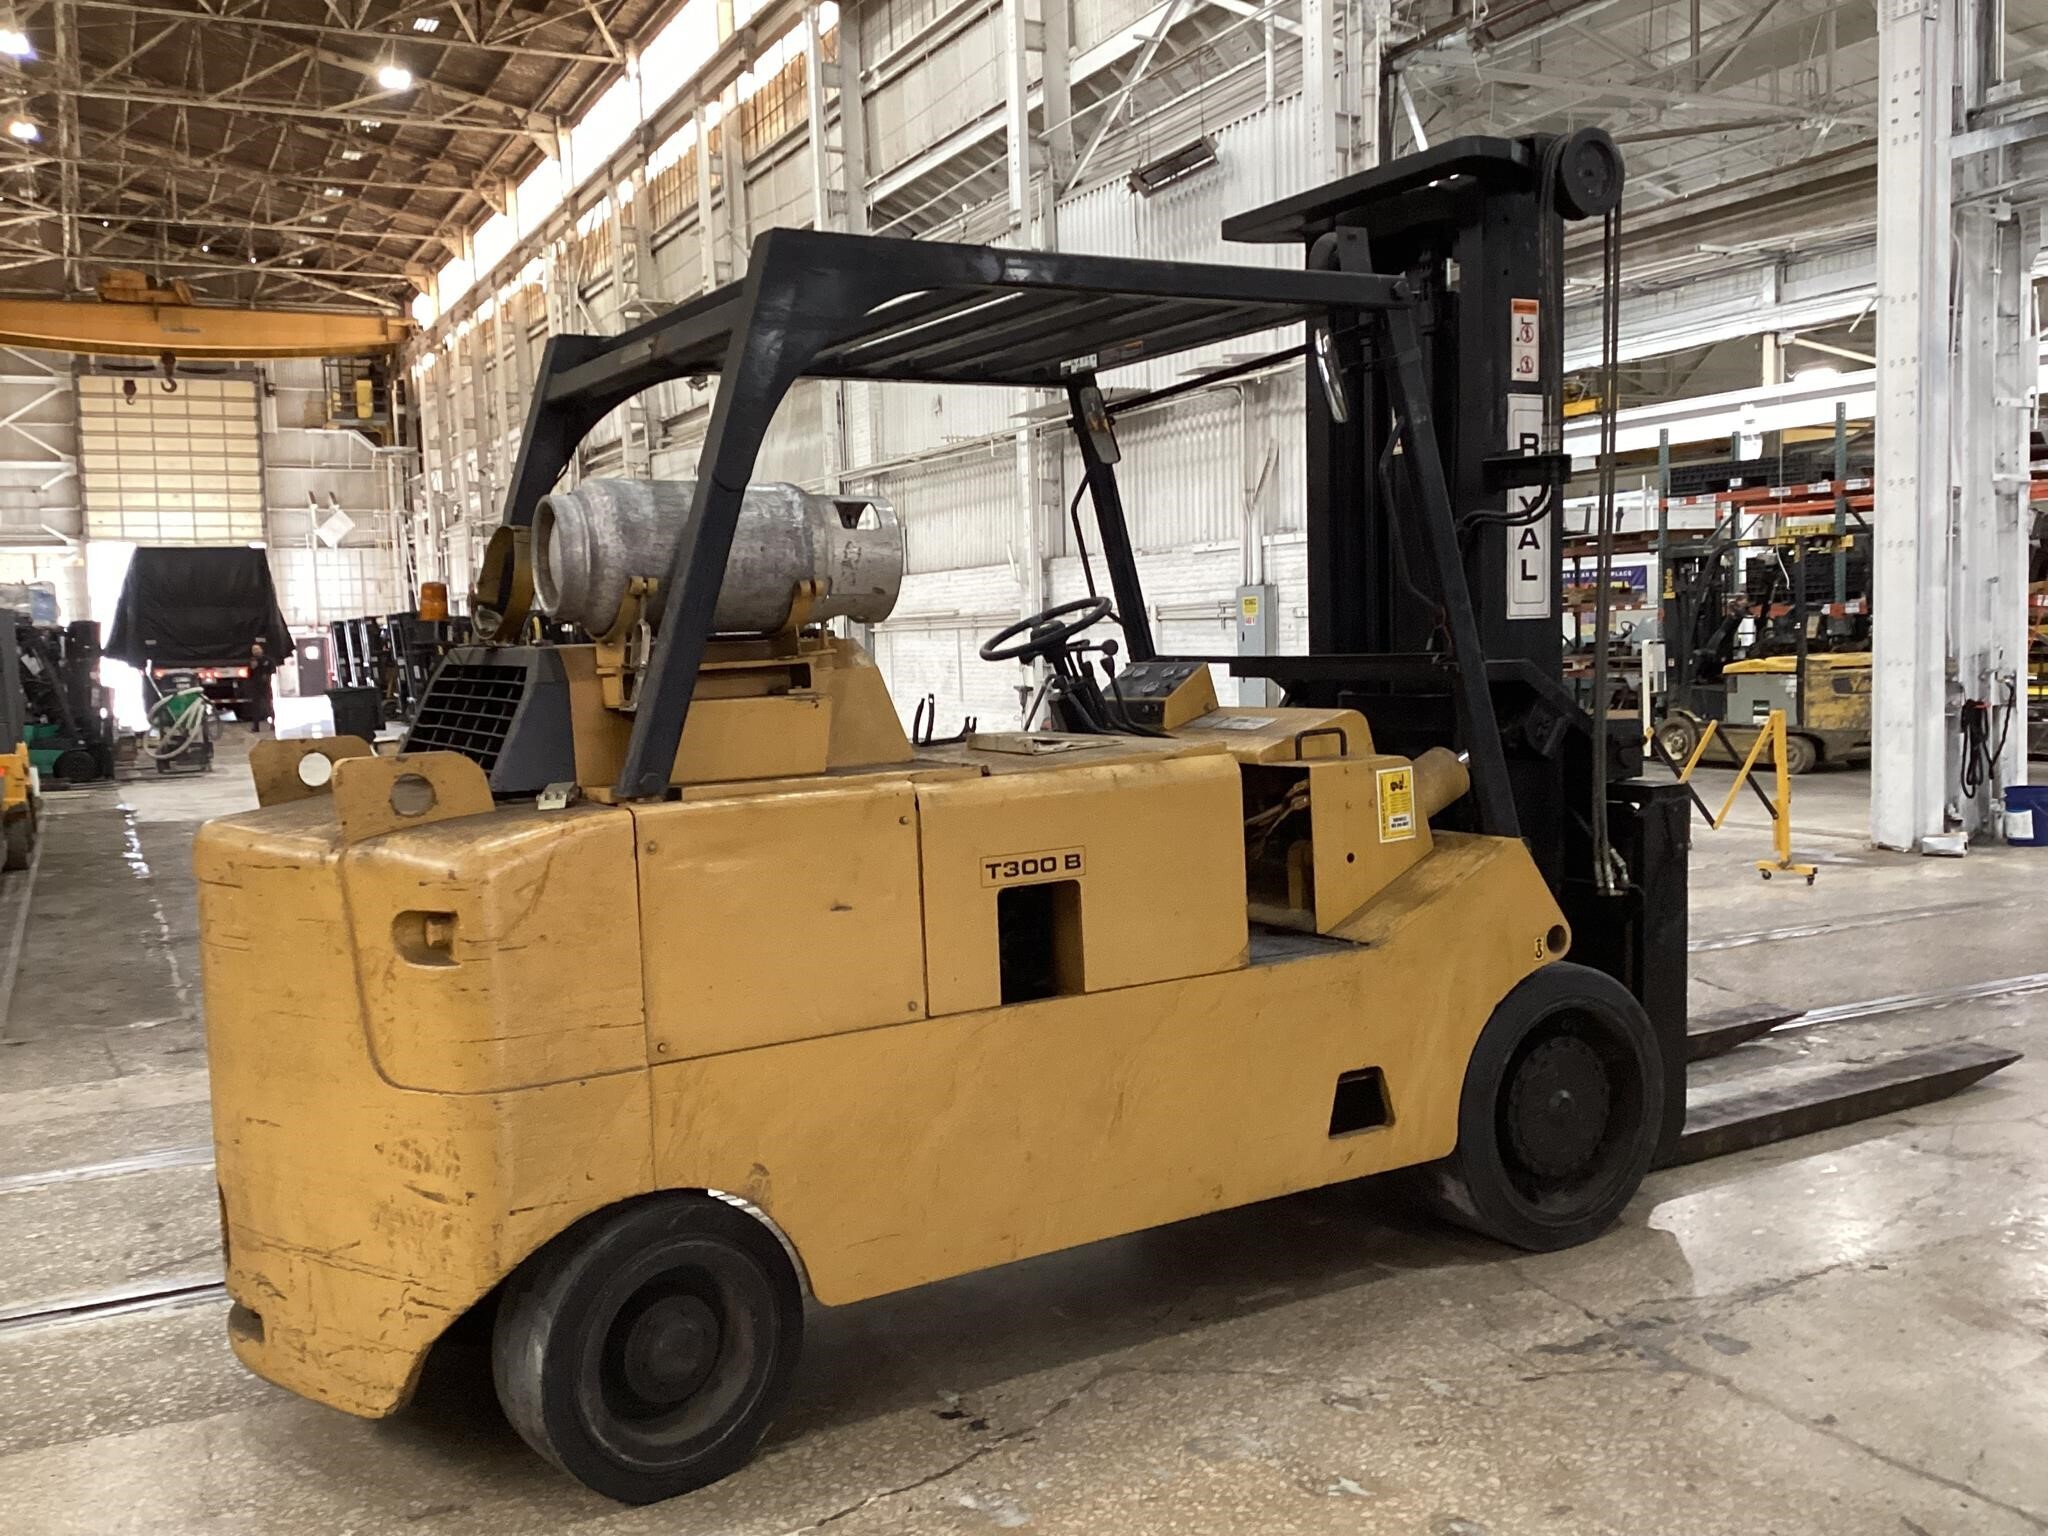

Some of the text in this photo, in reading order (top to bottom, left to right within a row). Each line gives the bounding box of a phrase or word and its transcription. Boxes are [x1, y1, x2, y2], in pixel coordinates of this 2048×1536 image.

[1517, 432, 1541, 581] RYAL
[985, 853, 1081, 880] T300 B
